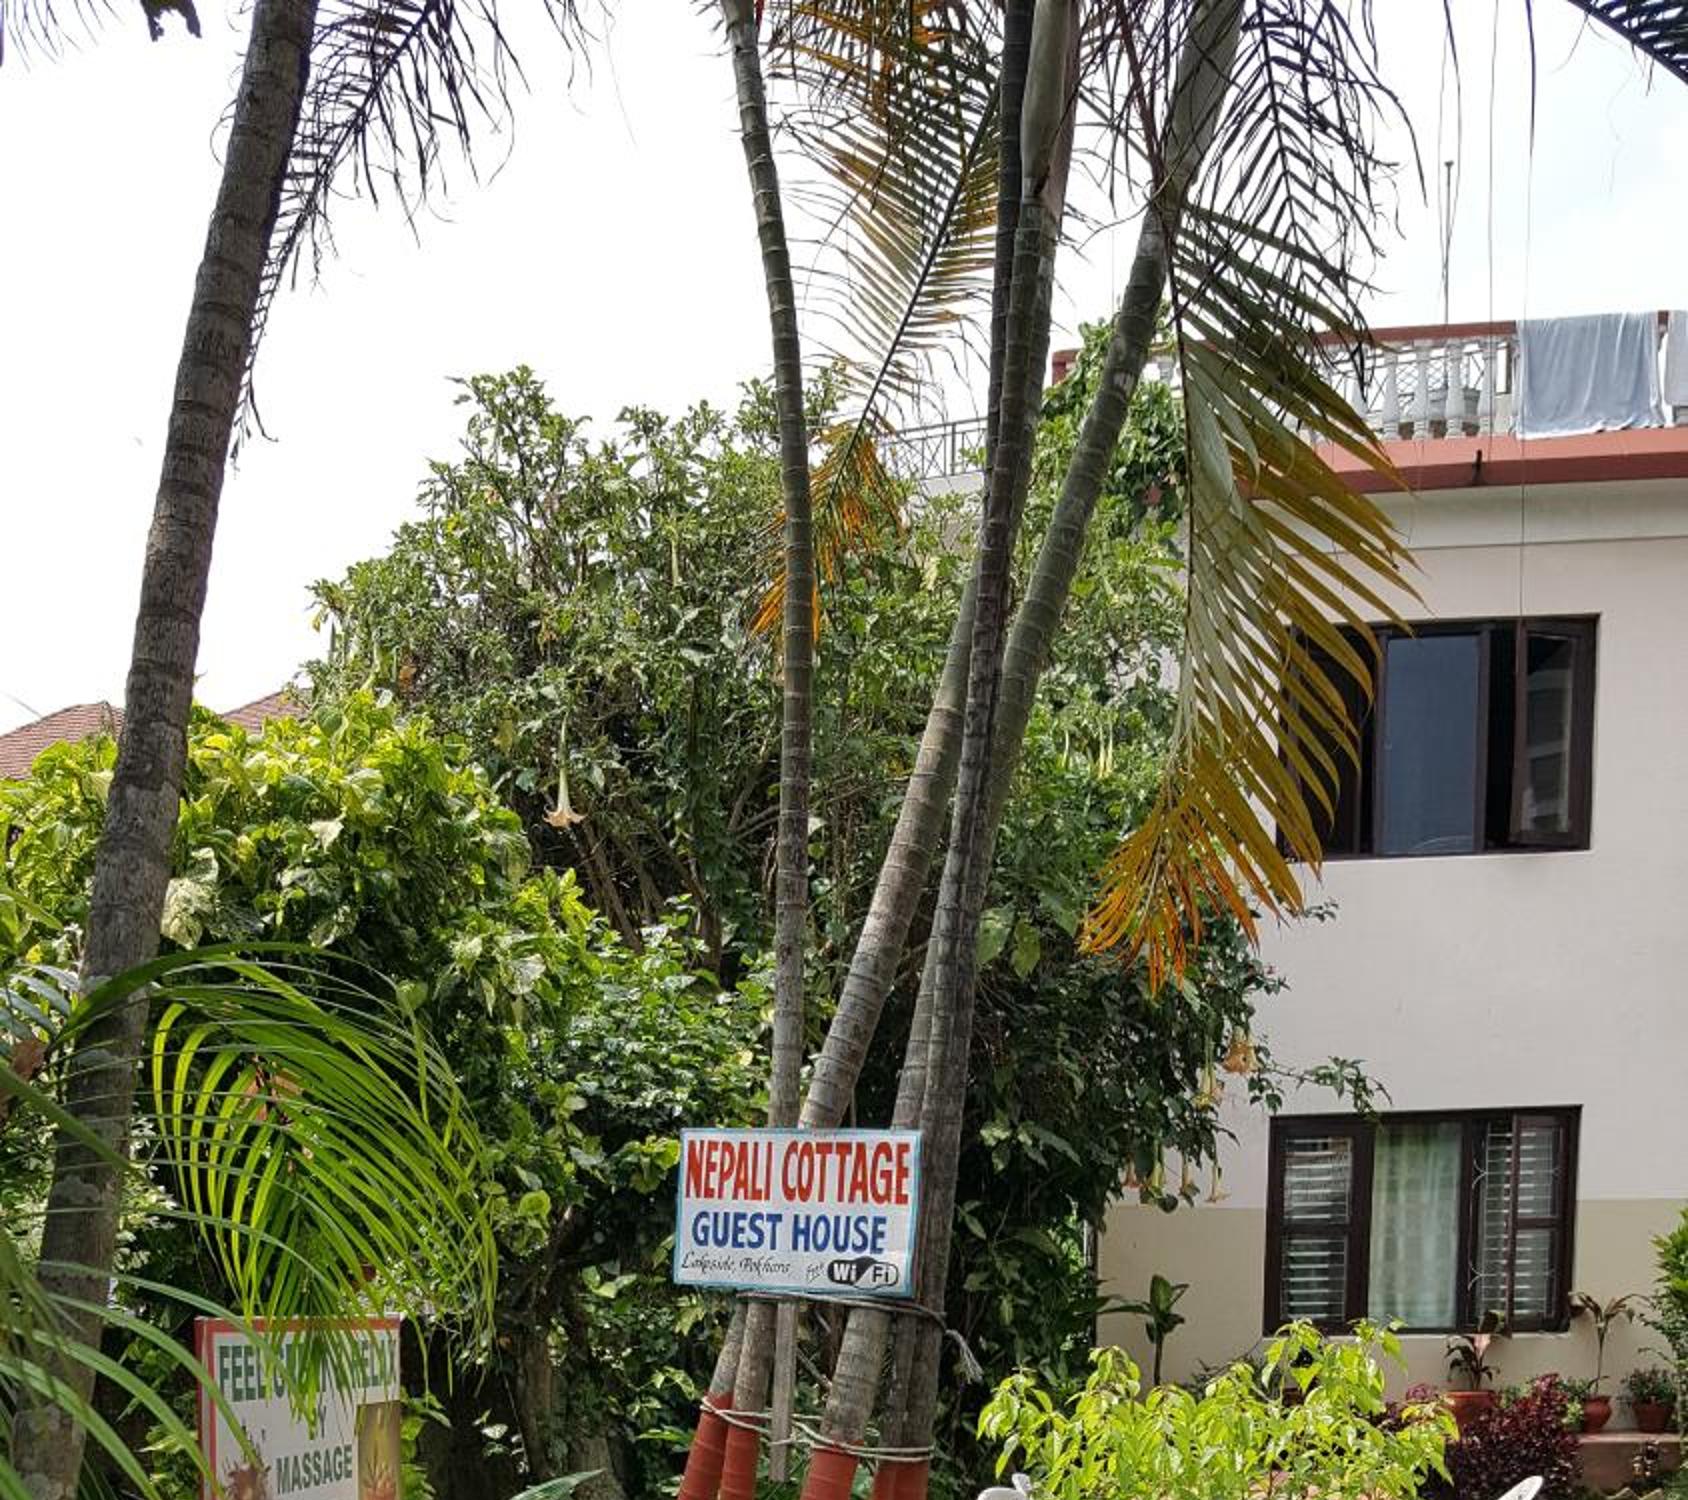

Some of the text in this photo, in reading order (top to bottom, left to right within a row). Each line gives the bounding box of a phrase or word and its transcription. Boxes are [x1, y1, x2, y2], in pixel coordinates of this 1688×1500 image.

[686, 1140, 911, 1205] NEPALI COTTAGE
[692, 1210, 888, 1255] GUEST HOUSE
[276, 1444, 352, 1494] MASSAGE
